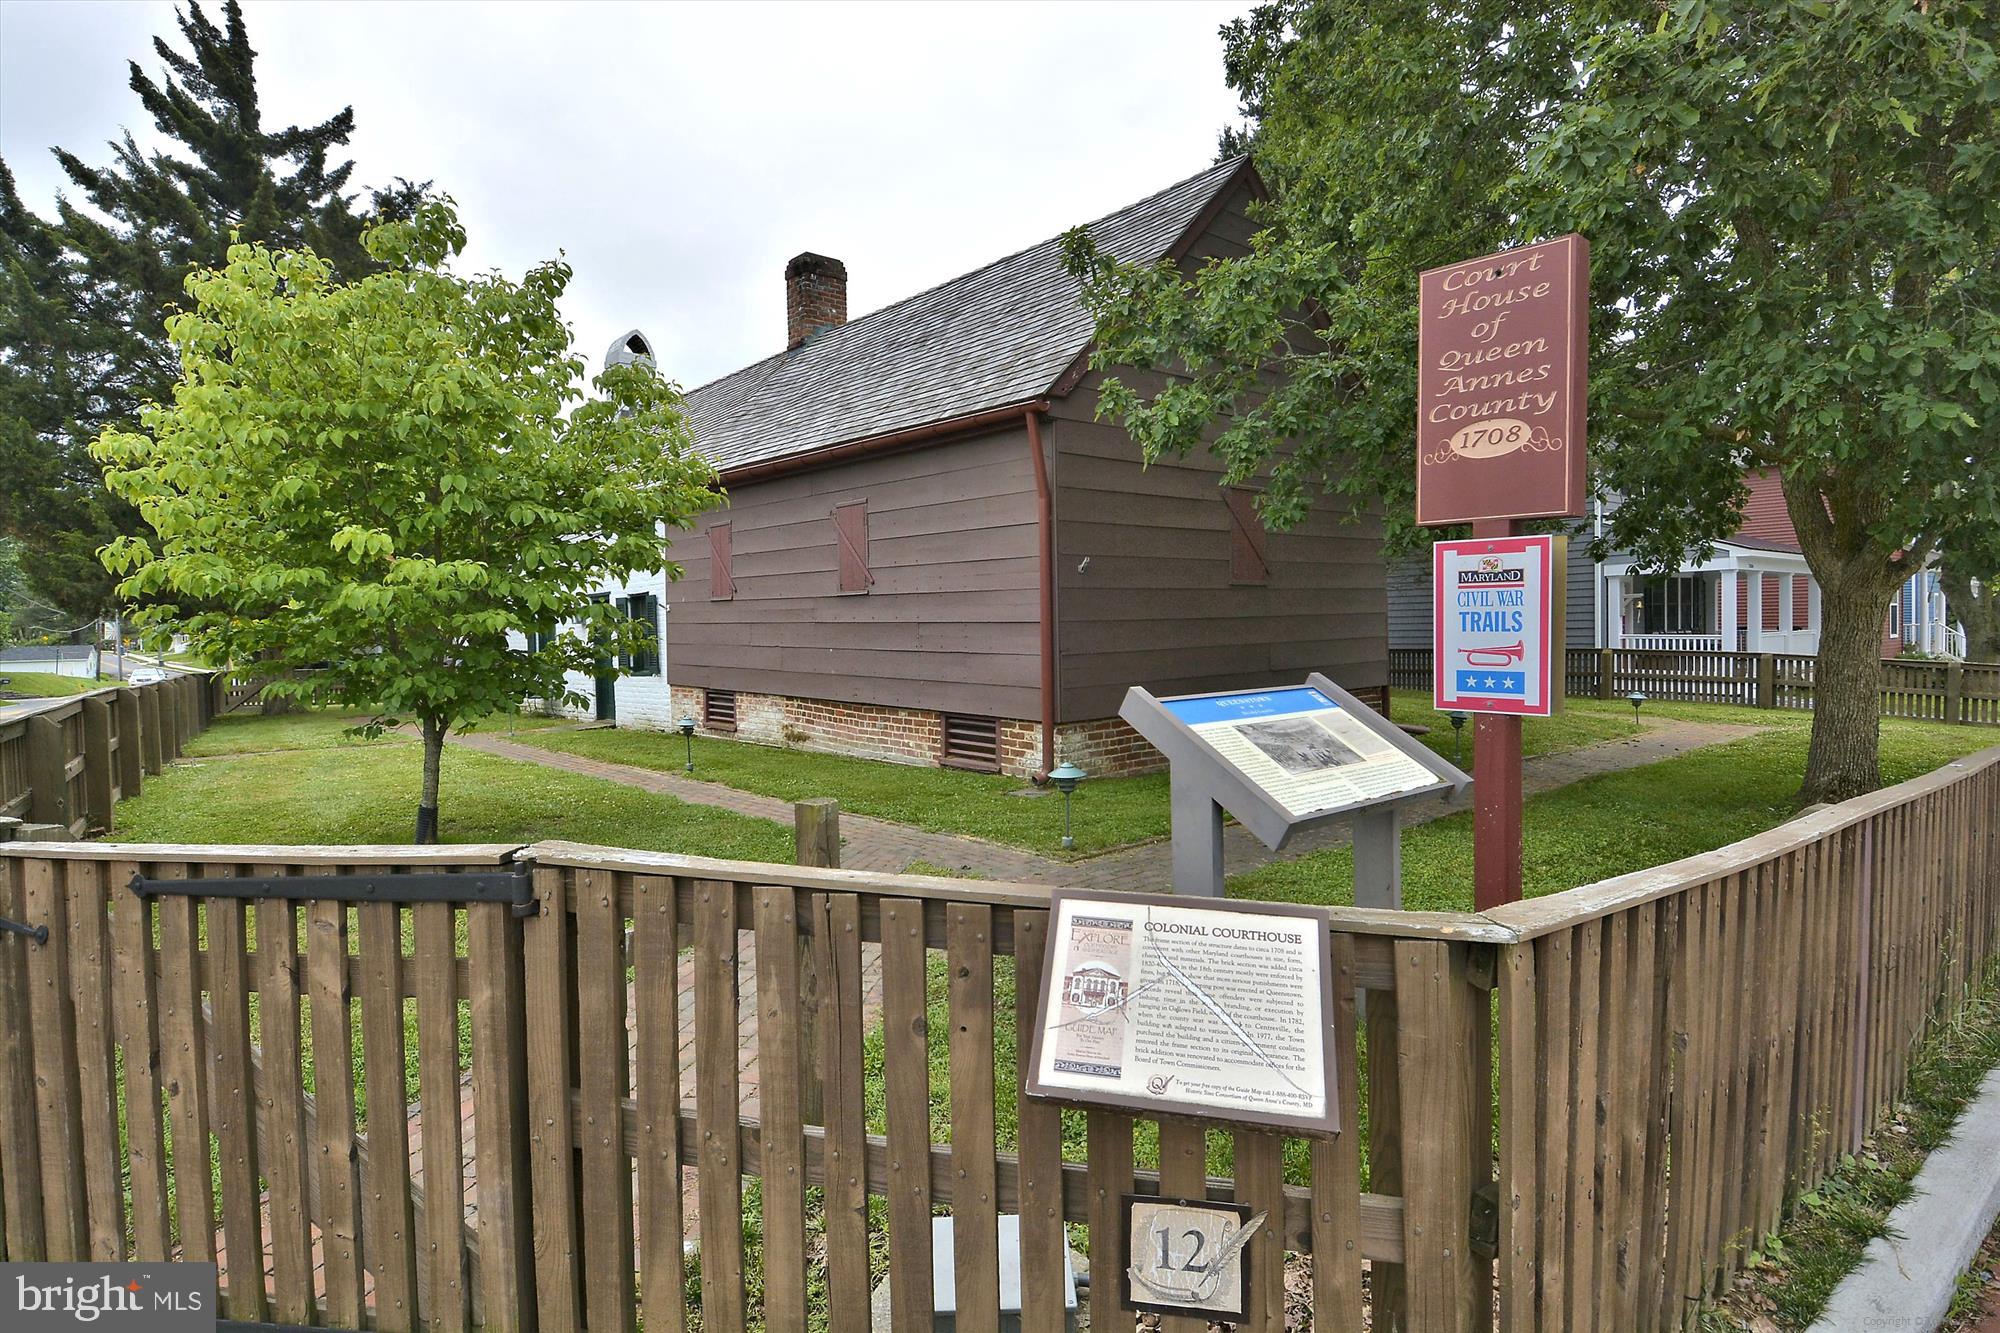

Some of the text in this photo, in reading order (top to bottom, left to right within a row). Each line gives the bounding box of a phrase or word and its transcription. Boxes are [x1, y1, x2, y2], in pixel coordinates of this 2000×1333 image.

[1442, 253, 1544, 291] Court
[1437, 281, 1550, 320] House
[1470, 311, 1511, 344] of
[1437, 337, 1549, 372] Queen
[1435, 364, 1551, 397] Annes
[1428, 390, 1558, 423] County
[1460, 425, 1521, 449] 1708
[1457, 590, 1524, 607] CIVIL WAR
[1459, 611, 1523, 632] TRAILS
[1071, 928, 1131, 947] EXPLORE
[1144, 922, 1302, 944] COLONIAL COURTHOUSE
[1203, 949, 1228, 958] Maryland
[1231, 952, 1262, 960] courthouses
[1287, 956, 1303, 965] form,
[1271, 947, 1284, 955] 1708
[1214, 968, 1234, 976] century
[1236, 969, 1254, 977] mostly
[1296, 974, 1302, 982] by
[1253, 979, 1288, 989] punishments
[1165, 987, 1182, 995] reveal
[1266, 997, 1293, 1007] subjected
[1213, 984, 1224, 992] post
[1266, 988, 1303, 999] Queenstown.
[1138, 1002, 1160, 1012] hanging
[1244, 1012, 1277, 1021] courthouse.
[1169, 1015, 1189, 1023] county
[1224, 1002, 1251, 1012] branding,
[1265, 1006, 1293, 1014] execution
[1297, 1009, 1304, 1017] by
[1136, 1029, 1164, 1039] purchased
[1177, 1033, 1200, 1043] building
[1279, 1043, 1304, 1052] coalition
[1137, 1020, 1160, 1030] building
[1175, 1024, 1197, 1033] adapted
[1288, 1035, 1305, 1043] Town
[1136, 1038, 1158, 1046] restored
[1172, 1041, 1188, 1049] frame
[1135, 1046, 1149, 1054] brick
[1151, 1048, 1174, 1056] addition
[1187, 1052, 1215, 1061] renovated
[1224, 1056, 1264, 1066] accommodate
[1135, 1055, 1151, 1063] Board
[1159, 1058, 1175, 1066] Town
[1176, 1060, 1221, 1070] Commissioners.
[1156, 1227, 1208, 1273] 12
